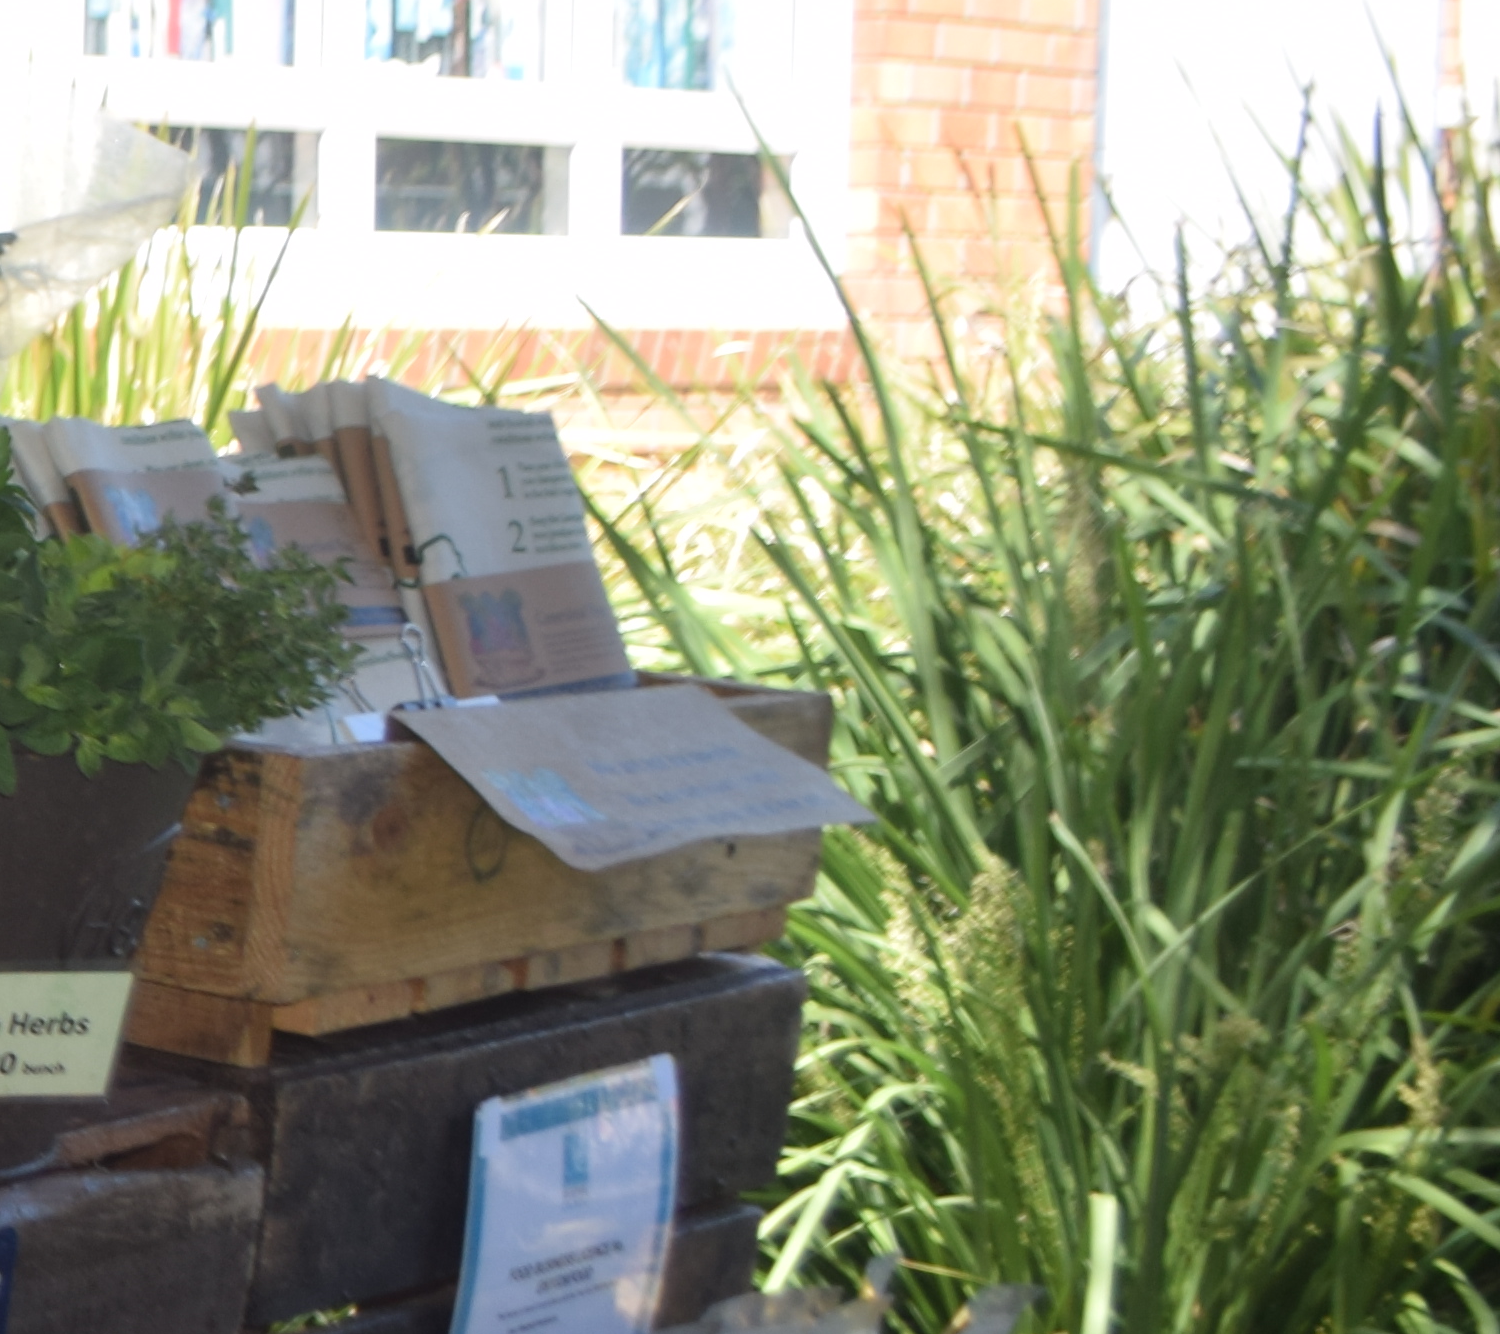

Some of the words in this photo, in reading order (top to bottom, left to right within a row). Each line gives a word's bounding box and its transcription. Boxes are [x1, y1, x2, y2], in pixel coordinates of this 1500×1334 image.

[497, 465, 514, 499] 1
[508, 519, 527, 553] 2
[8, 1011, 90, 1036] Herbs
